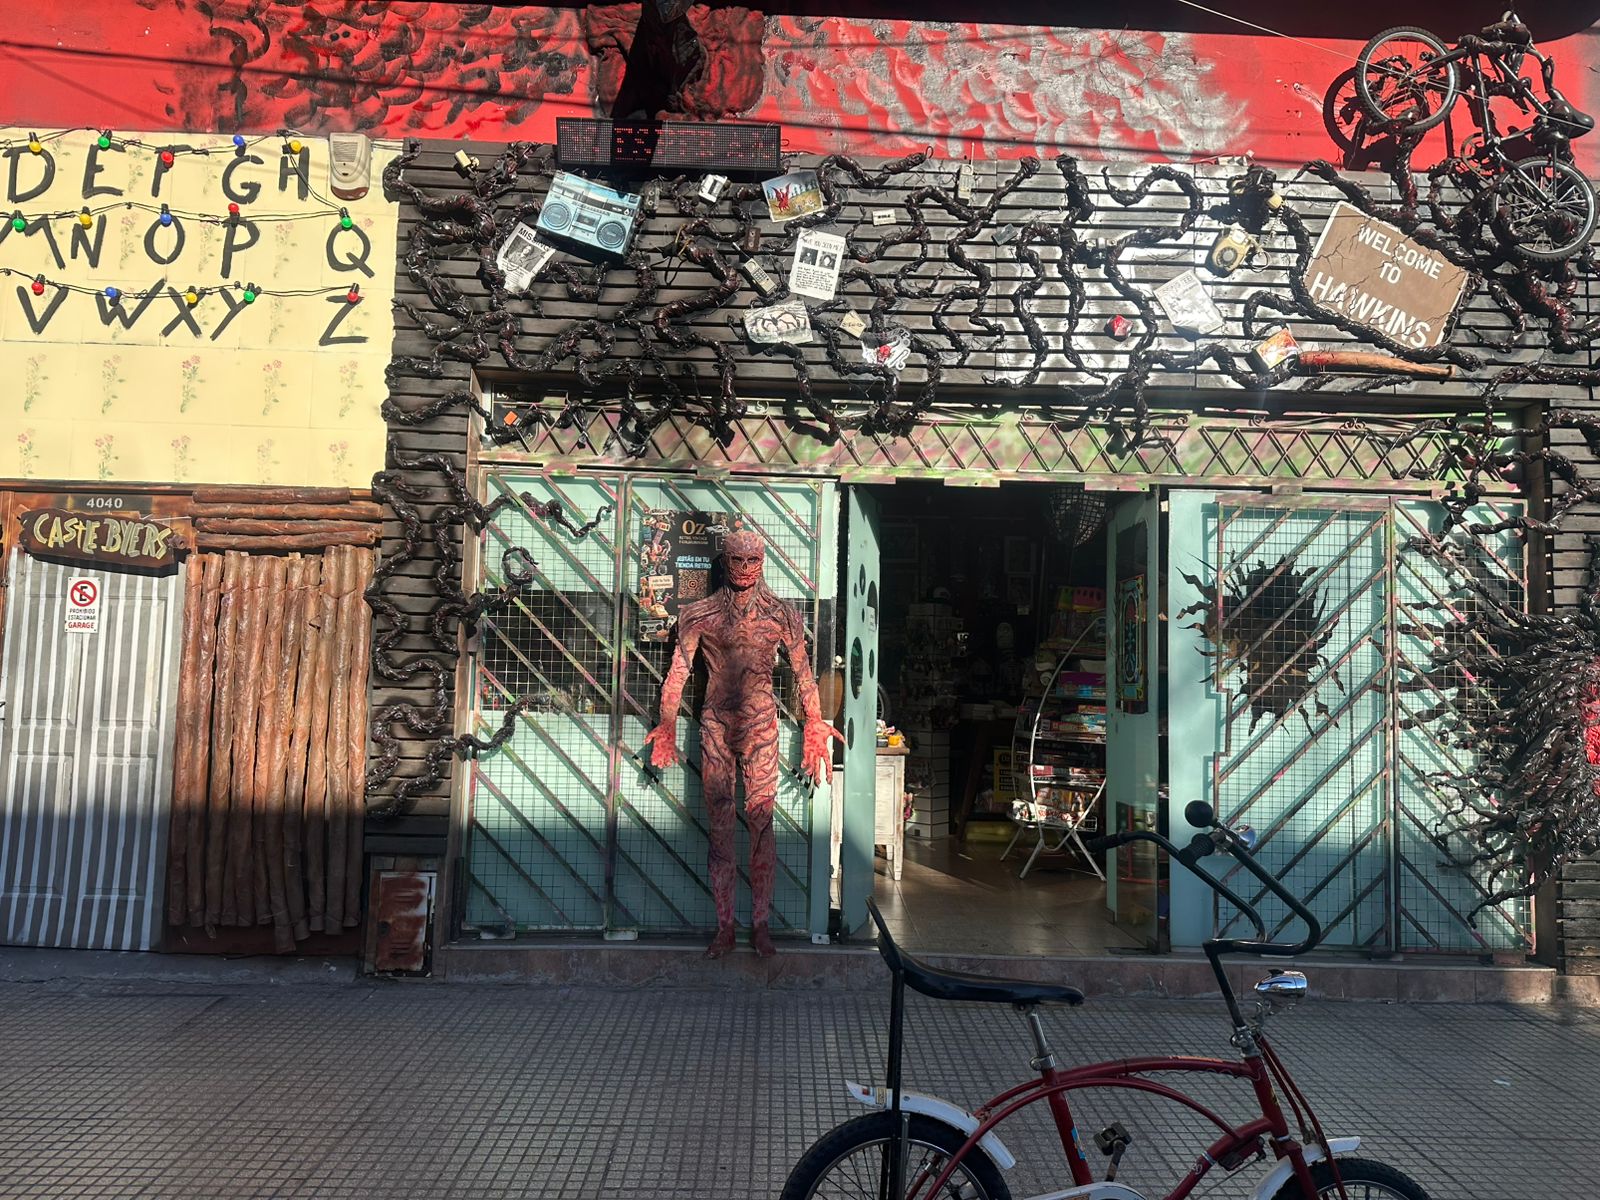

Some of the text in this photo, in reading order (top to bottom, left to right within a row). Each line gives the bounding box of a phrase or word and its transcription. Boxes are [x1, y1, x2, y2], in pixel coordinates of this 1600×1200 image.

[3, 144, 56, 203] D
[82, 143, 126, 199] E
[222, 155, 264, 204] G
[279, 145, 310, 200] H
[71, 213, 107, 268] N
[143, 215, 186, 265] O
[220, 216, 261, 278] P
[326, 222, 375, 279] Q
[1358, 227, 1444, 281] WELCOME
[1380, 262, 1402, 285] TO
[16, 279, 370, 346] V W X Y Z
[1308, 271, 1431, 348] HAWKINS
[86, 497, 123, 509] 4040
[101, 518, 172, 560] BYERS
[67, 621, 95, 629] GARAGE
